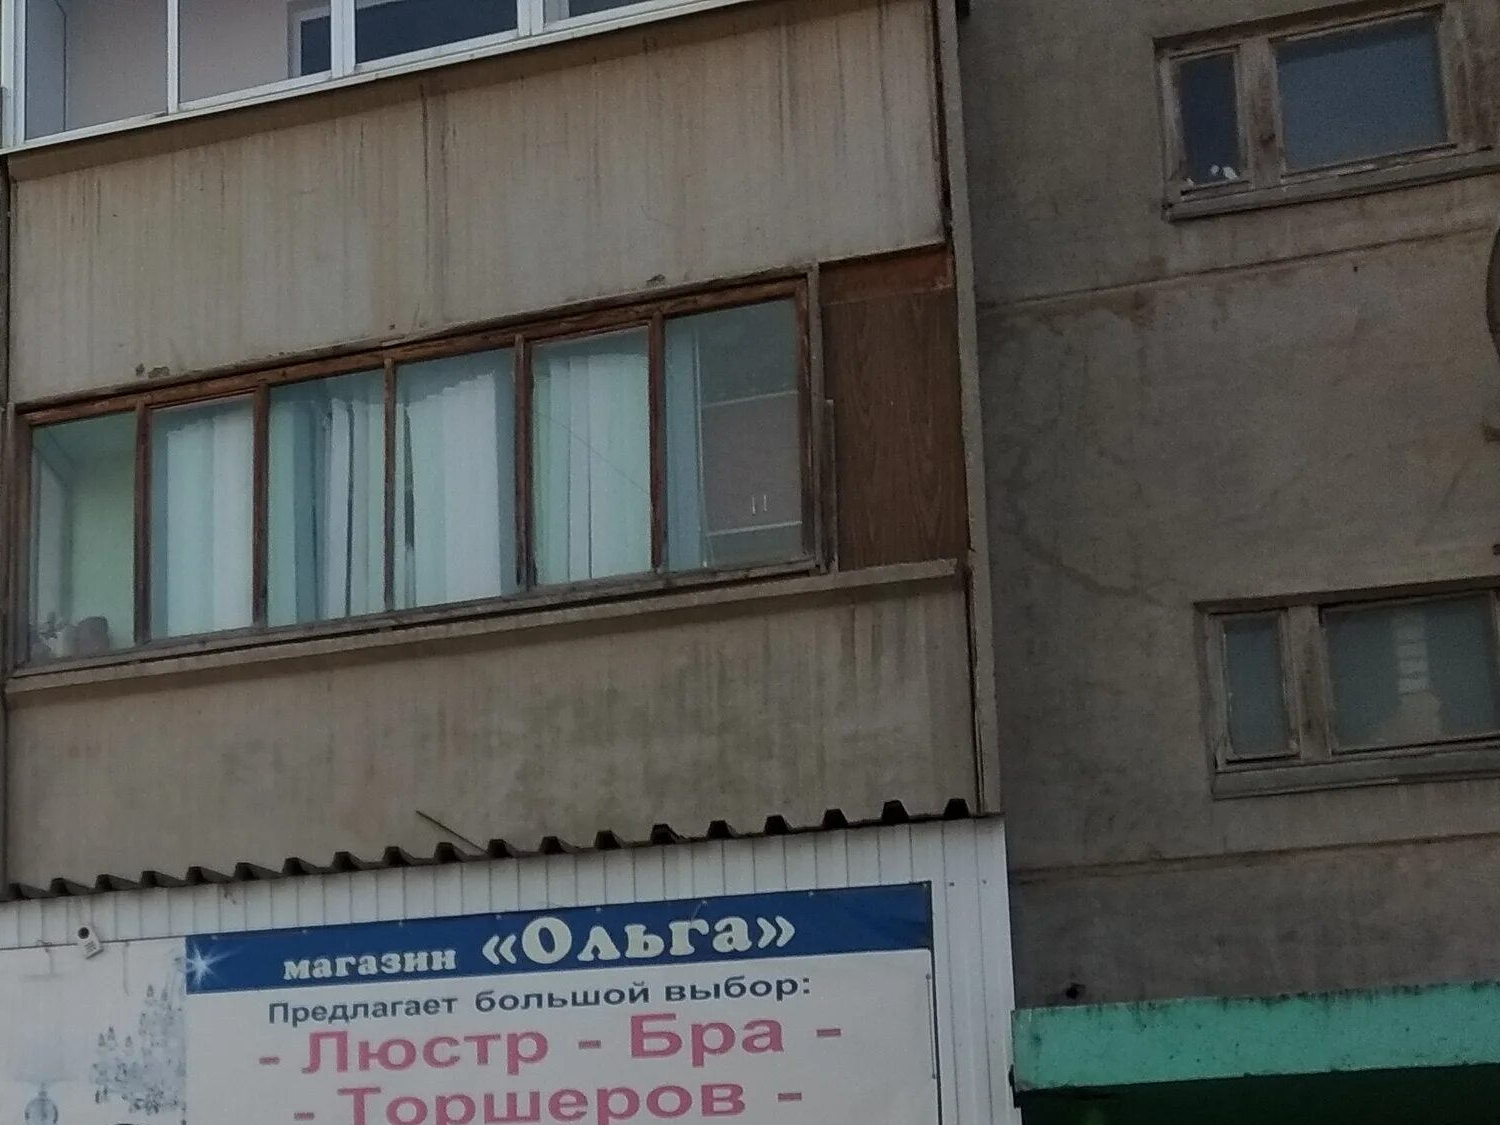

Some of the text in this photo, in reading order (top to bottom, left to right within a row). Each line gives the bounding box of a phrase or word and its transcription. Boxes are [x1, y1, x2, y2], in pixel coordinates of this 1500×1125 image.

[283, 914, 796, 981] магазин «Ольга»
[268, 975, 812, 1027] Предлагает большой выбор:
[301, 1030, 549, 1076] Люстр
[630, 1013, 785, 1068] Бра
